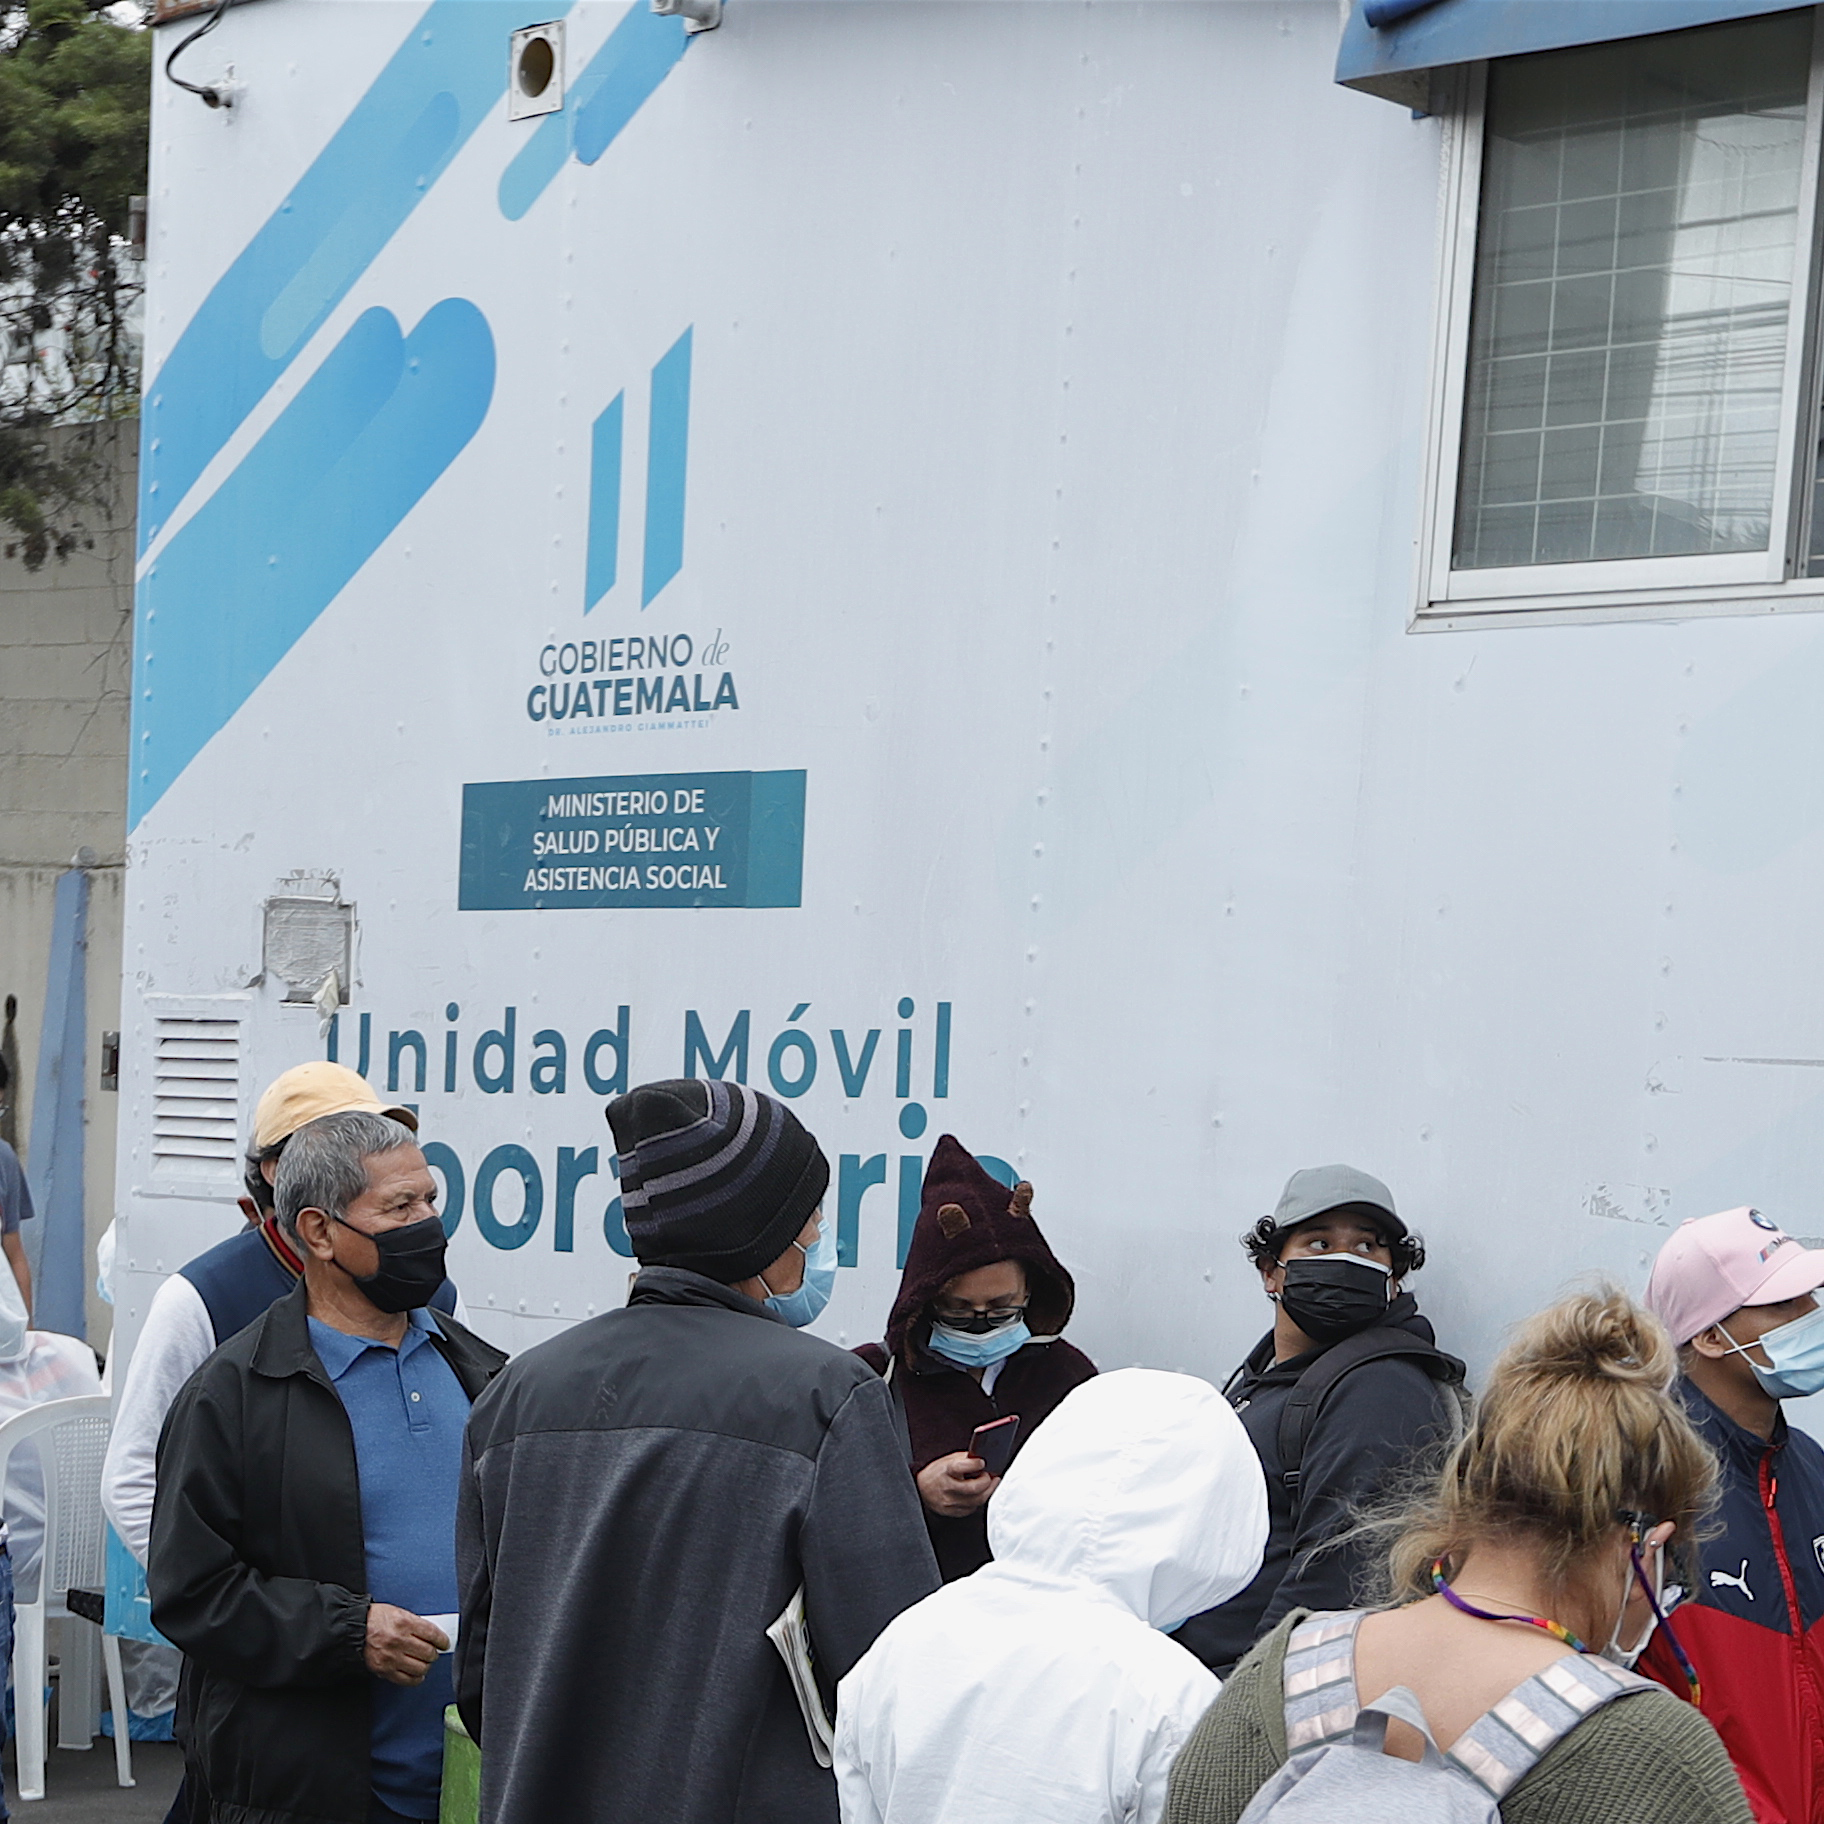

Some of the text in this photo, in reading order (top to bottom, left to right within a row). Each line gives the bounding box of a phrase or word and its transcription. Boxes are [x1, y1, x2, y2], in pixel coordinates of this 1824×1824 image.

[539, 628, 730, 677] GOBIERNO de
[526, 672, 740, 722] GUATEMALA
[547, 719, 709, 737] DR. ALEJANDRO GIAMMATTEI
[547, 789, 705, 818] MINISTERIO DE
[533, 823, 720, 855] SALUD PÚBLICA Y
[523, 865, 727, 892] ASISTENCIA SOCIAL
[327, 997, 952, 1099] Unidad Móvil
